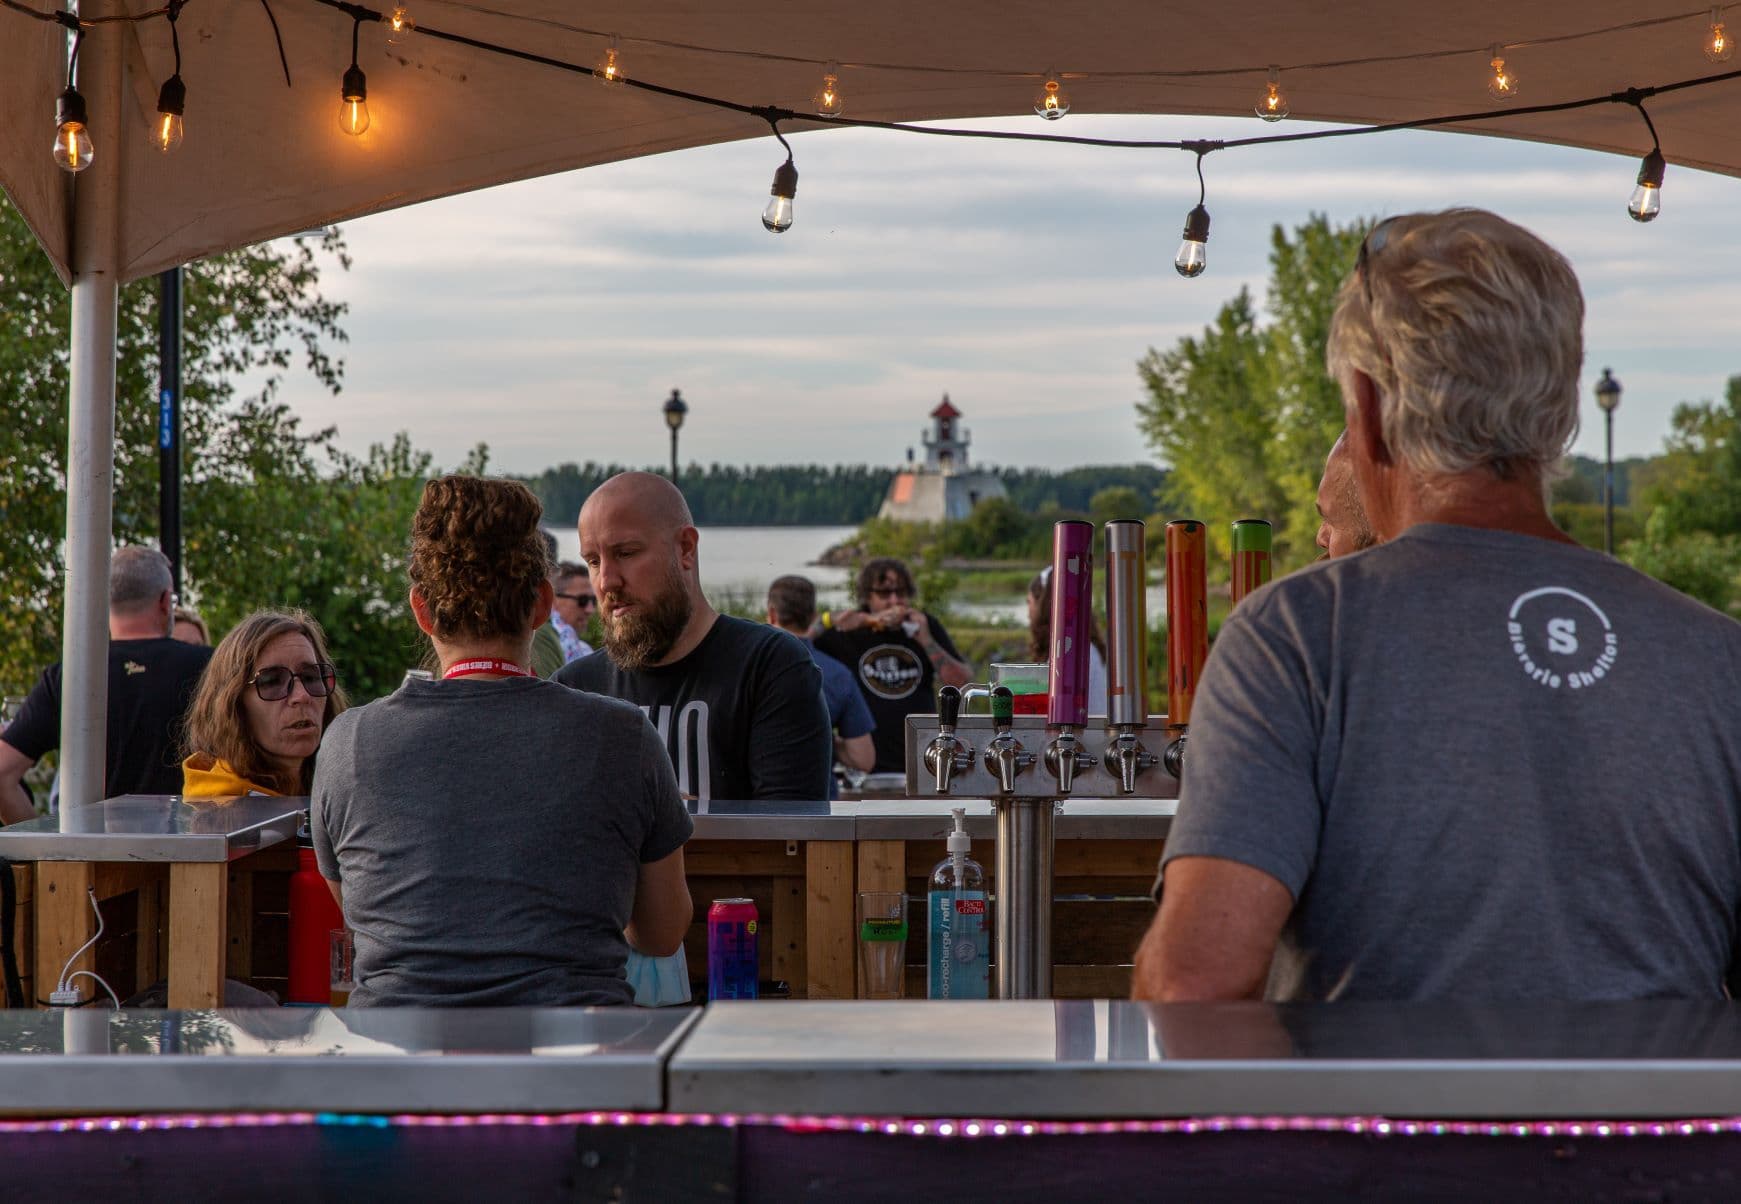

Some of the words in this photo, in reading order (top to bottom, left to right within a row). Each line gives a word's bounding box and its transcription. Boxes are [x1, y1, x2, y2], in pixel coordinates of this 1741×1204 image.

[1547, 617, 1579, 655] S
[1568, 633, 1617, 688] Shelton
[941, 898, 950, 922] refill
[940, 931, 952, 1000] co-recharge
